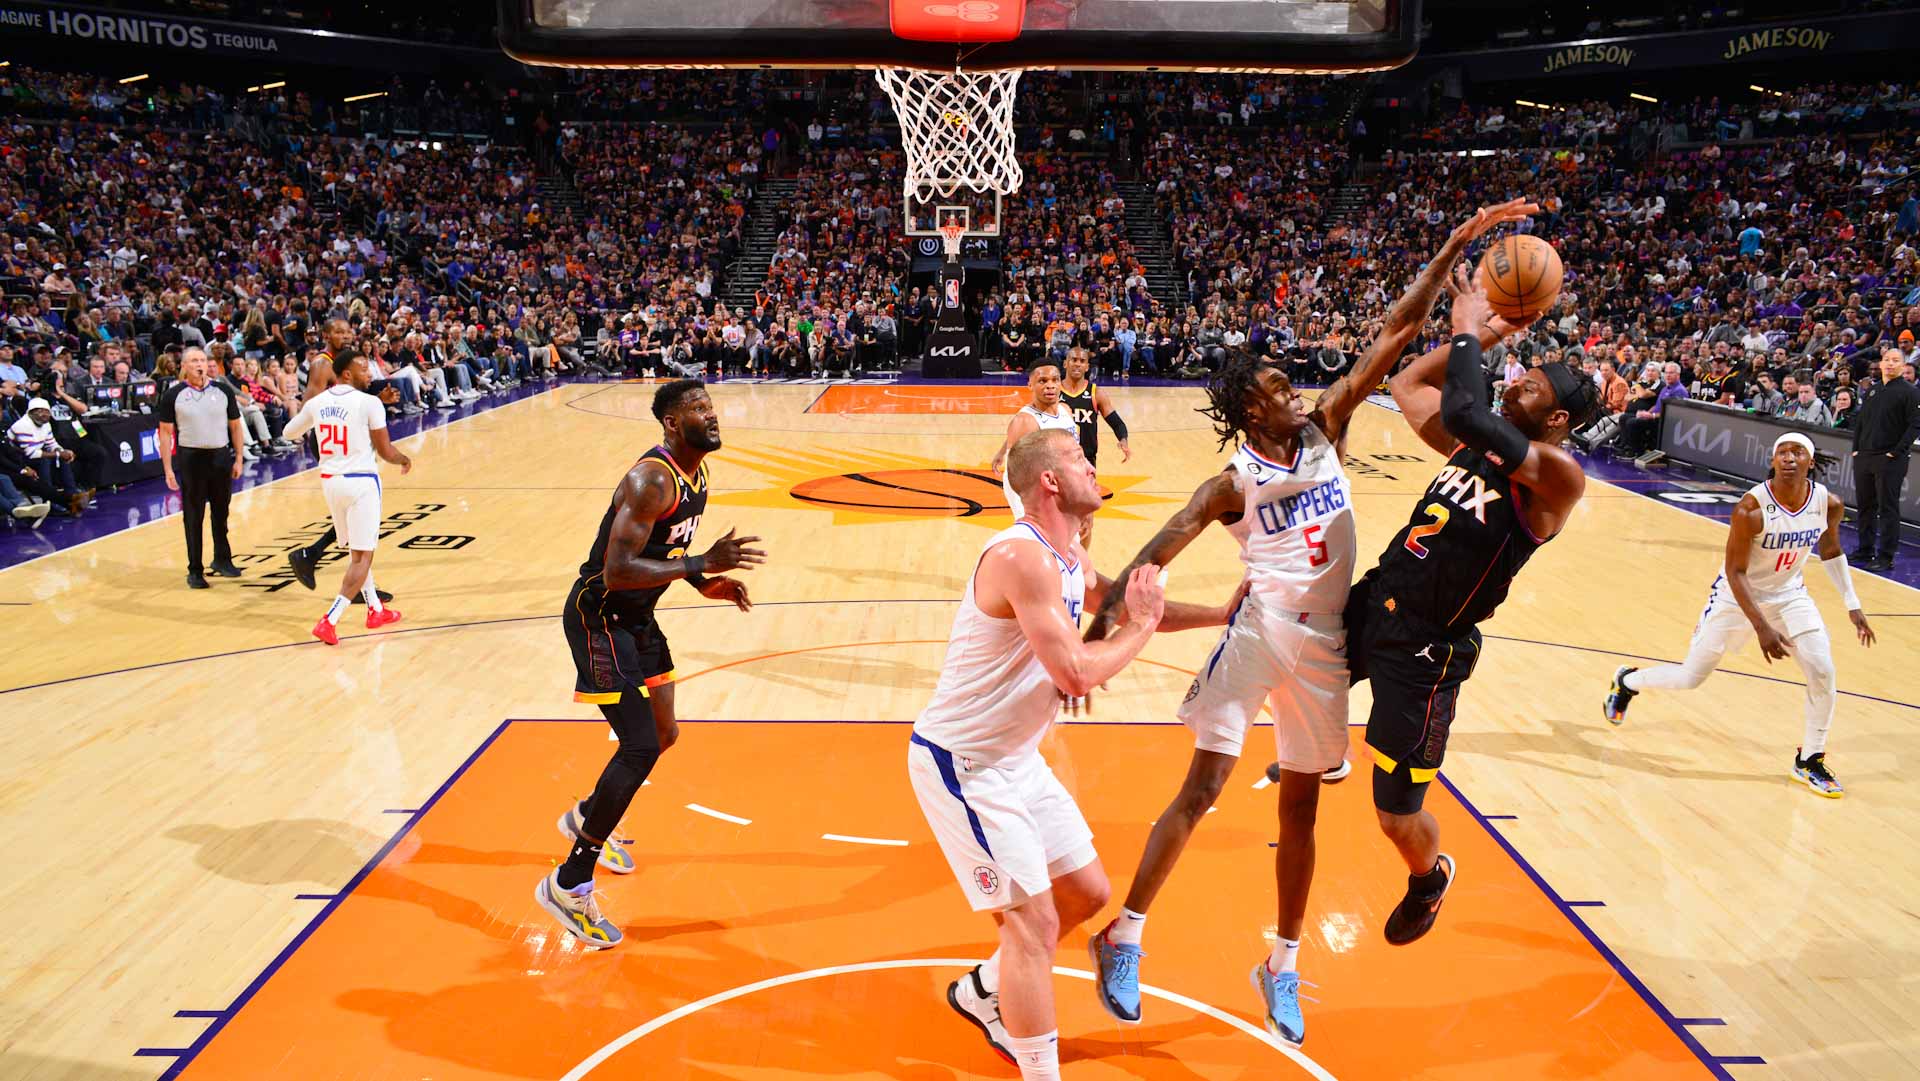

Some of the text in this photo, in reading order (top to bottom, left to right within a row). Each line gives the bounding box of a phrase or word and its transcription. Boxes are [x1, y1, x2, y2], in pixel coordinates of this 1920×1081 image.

[0, 9, 278, 51] AGAVE HORNITOS TEQUILA
[1723, 27, 1831, 59] JAMESON
[1543, 45, 1632, 73] JAMESON
[320, 406, 348, 420] POWELL
[319, 424, 348, 457] 24
[1257, 476, 1345, 535] CLIPPERS
[1429, 465, 1502, 524] PHX
[665, 514, 702, 545] PH
[1404, 502, 1450, 559] 2
[1762, 528, 1820, 549] CLIPPERS
[1303, 525, 1329, 567] 5
[1775, 552, 1798, 572] 14
